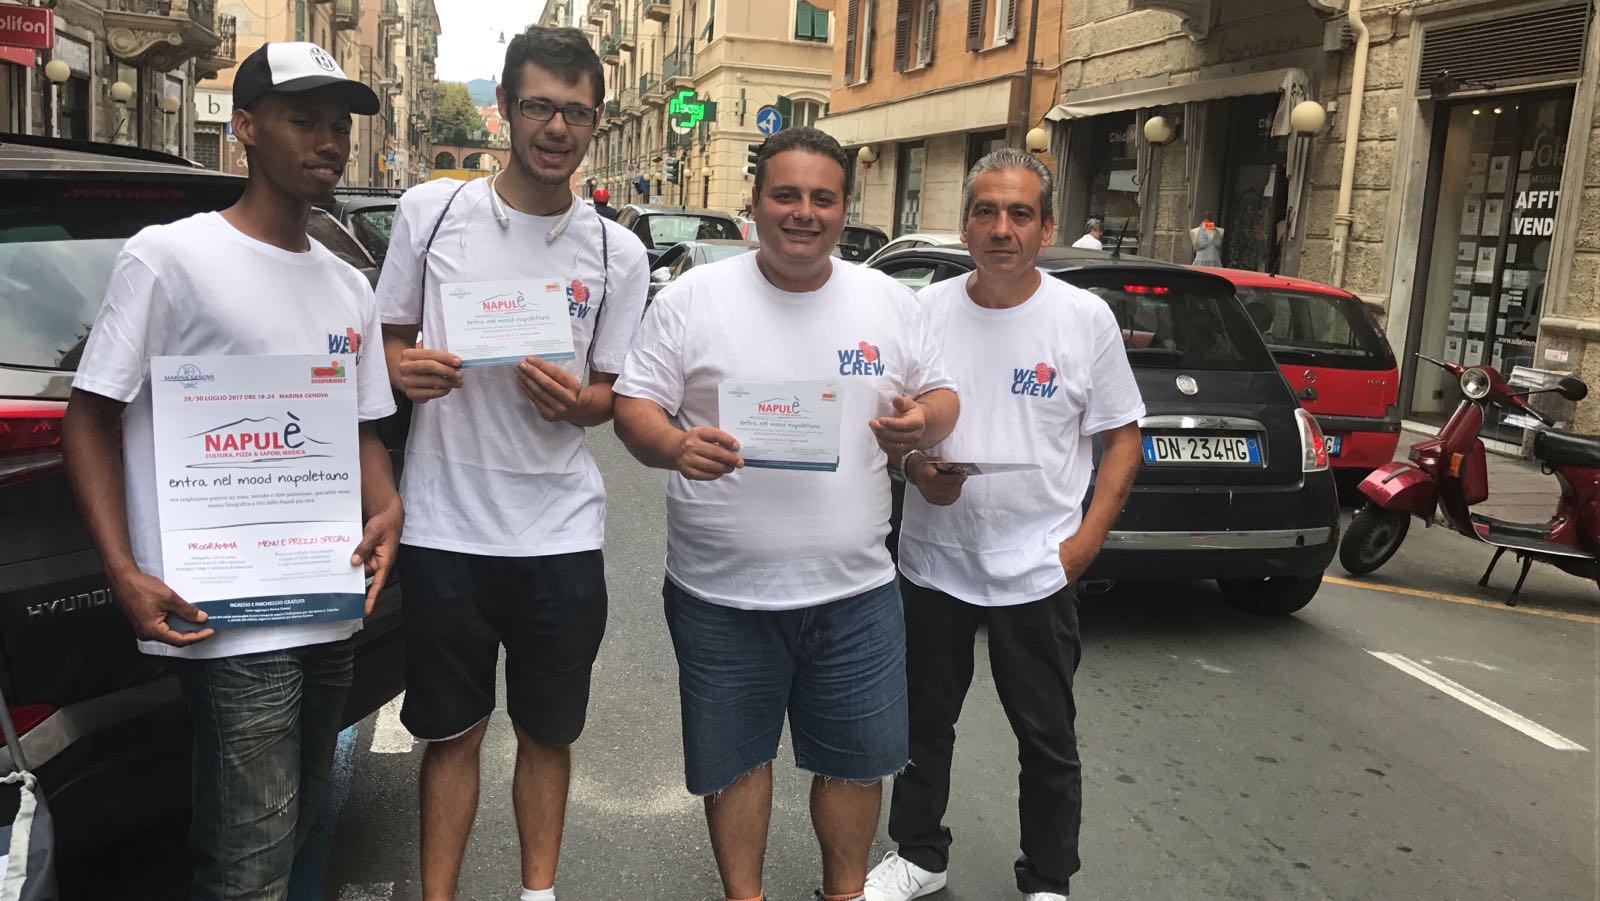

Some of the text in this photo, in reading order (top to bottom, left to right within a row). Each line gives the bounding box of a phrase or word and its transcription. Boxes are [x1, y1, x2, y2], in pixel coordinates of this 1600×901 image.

[208, 94, 220, 114] b
[1514, 217, 1554, 236] VEND
[569, 301, 591, 319] EW
[838, 349, 864, 363] WE
[839, 362, 885, 376] CREW
[1011, 381, 1058, 398] CREW
[1155, 437, 1248, 461] DN 234HG
[169, 470, 349, 490] entra nel mood napoletano
[187, 541, 238, 550] PROGRAMMA
[257, 534, 350, 548] MENU E PREZZI SPECIALI
[27, 588, 113, 617] HYUND
